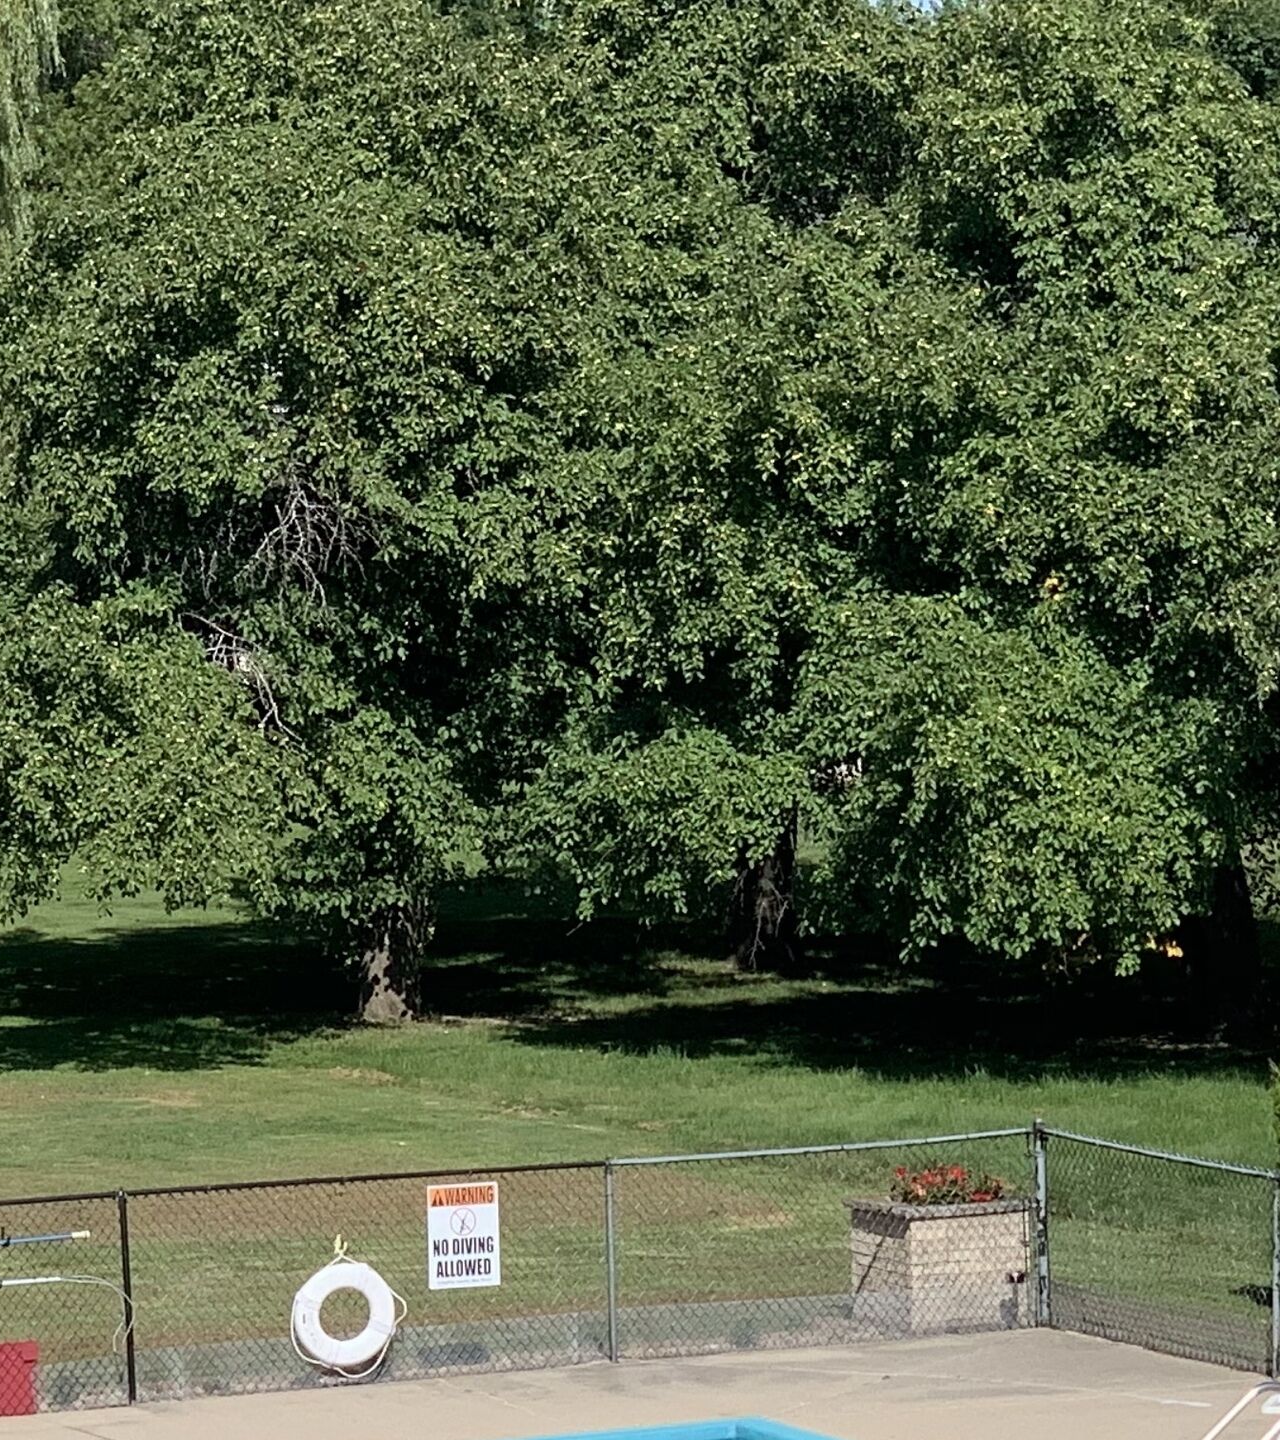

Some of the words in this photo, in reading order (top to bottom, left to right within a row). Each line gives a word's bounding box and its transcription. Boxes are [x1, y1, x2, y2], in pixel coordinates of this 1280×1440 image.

[445, 1185, 494, 1206] WARNING
[433, 1239, 449, 1257] NO
[452, 1236, 494, 1255] DIVING
[436, 1258, 491, 1278] ALLOWED
